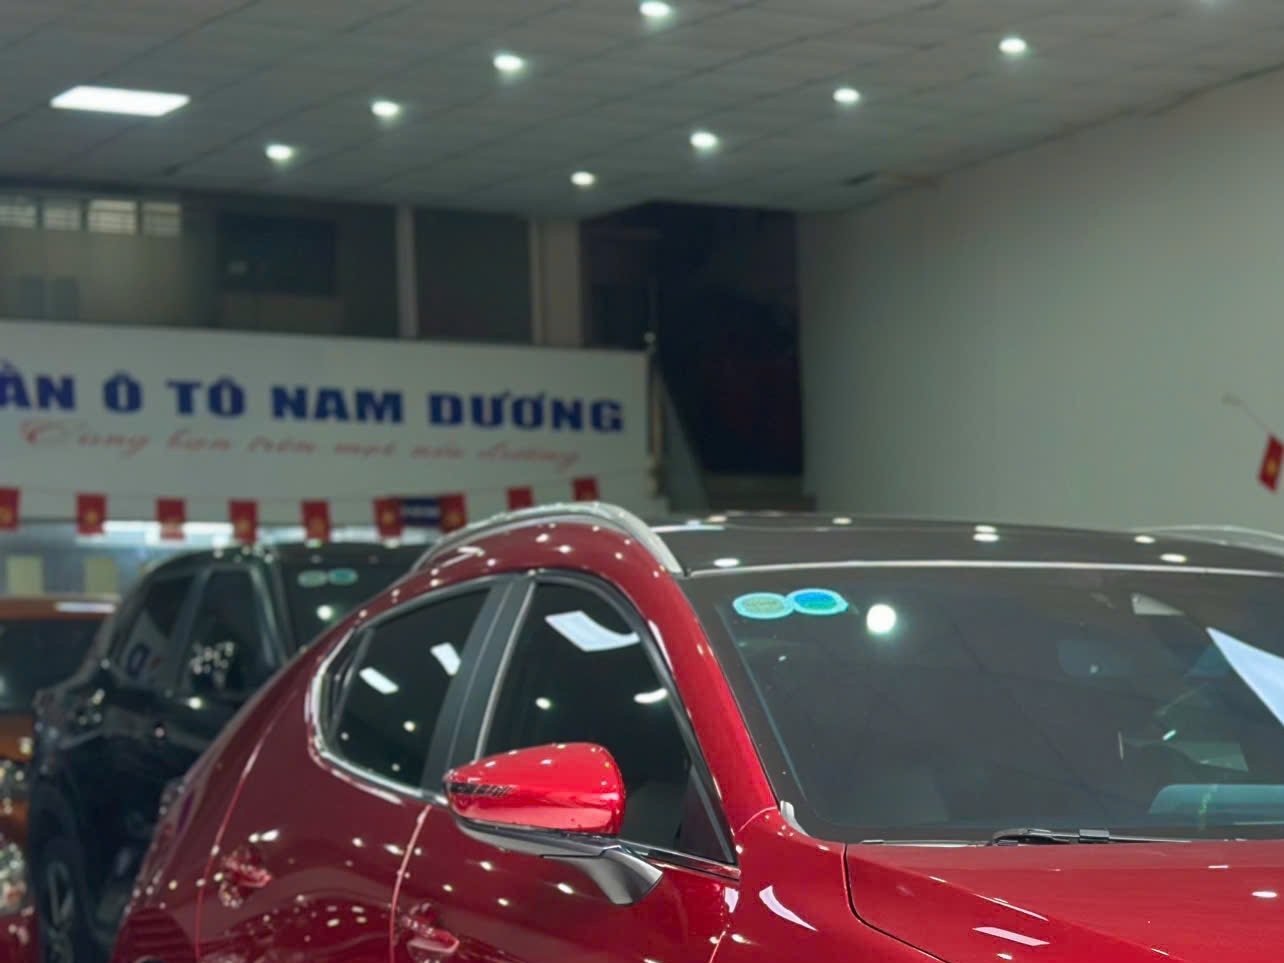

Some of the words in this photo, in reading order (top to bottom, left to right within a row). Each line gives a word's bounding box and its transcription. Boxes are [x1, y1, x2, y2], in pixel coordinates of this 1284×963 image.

[102, 370, 143, 414] Ô
[165, 375, 246, 419] TÔ
[270, 384, 404, 424] NAM
[428, 388, 625, 433] DƯƠNG
